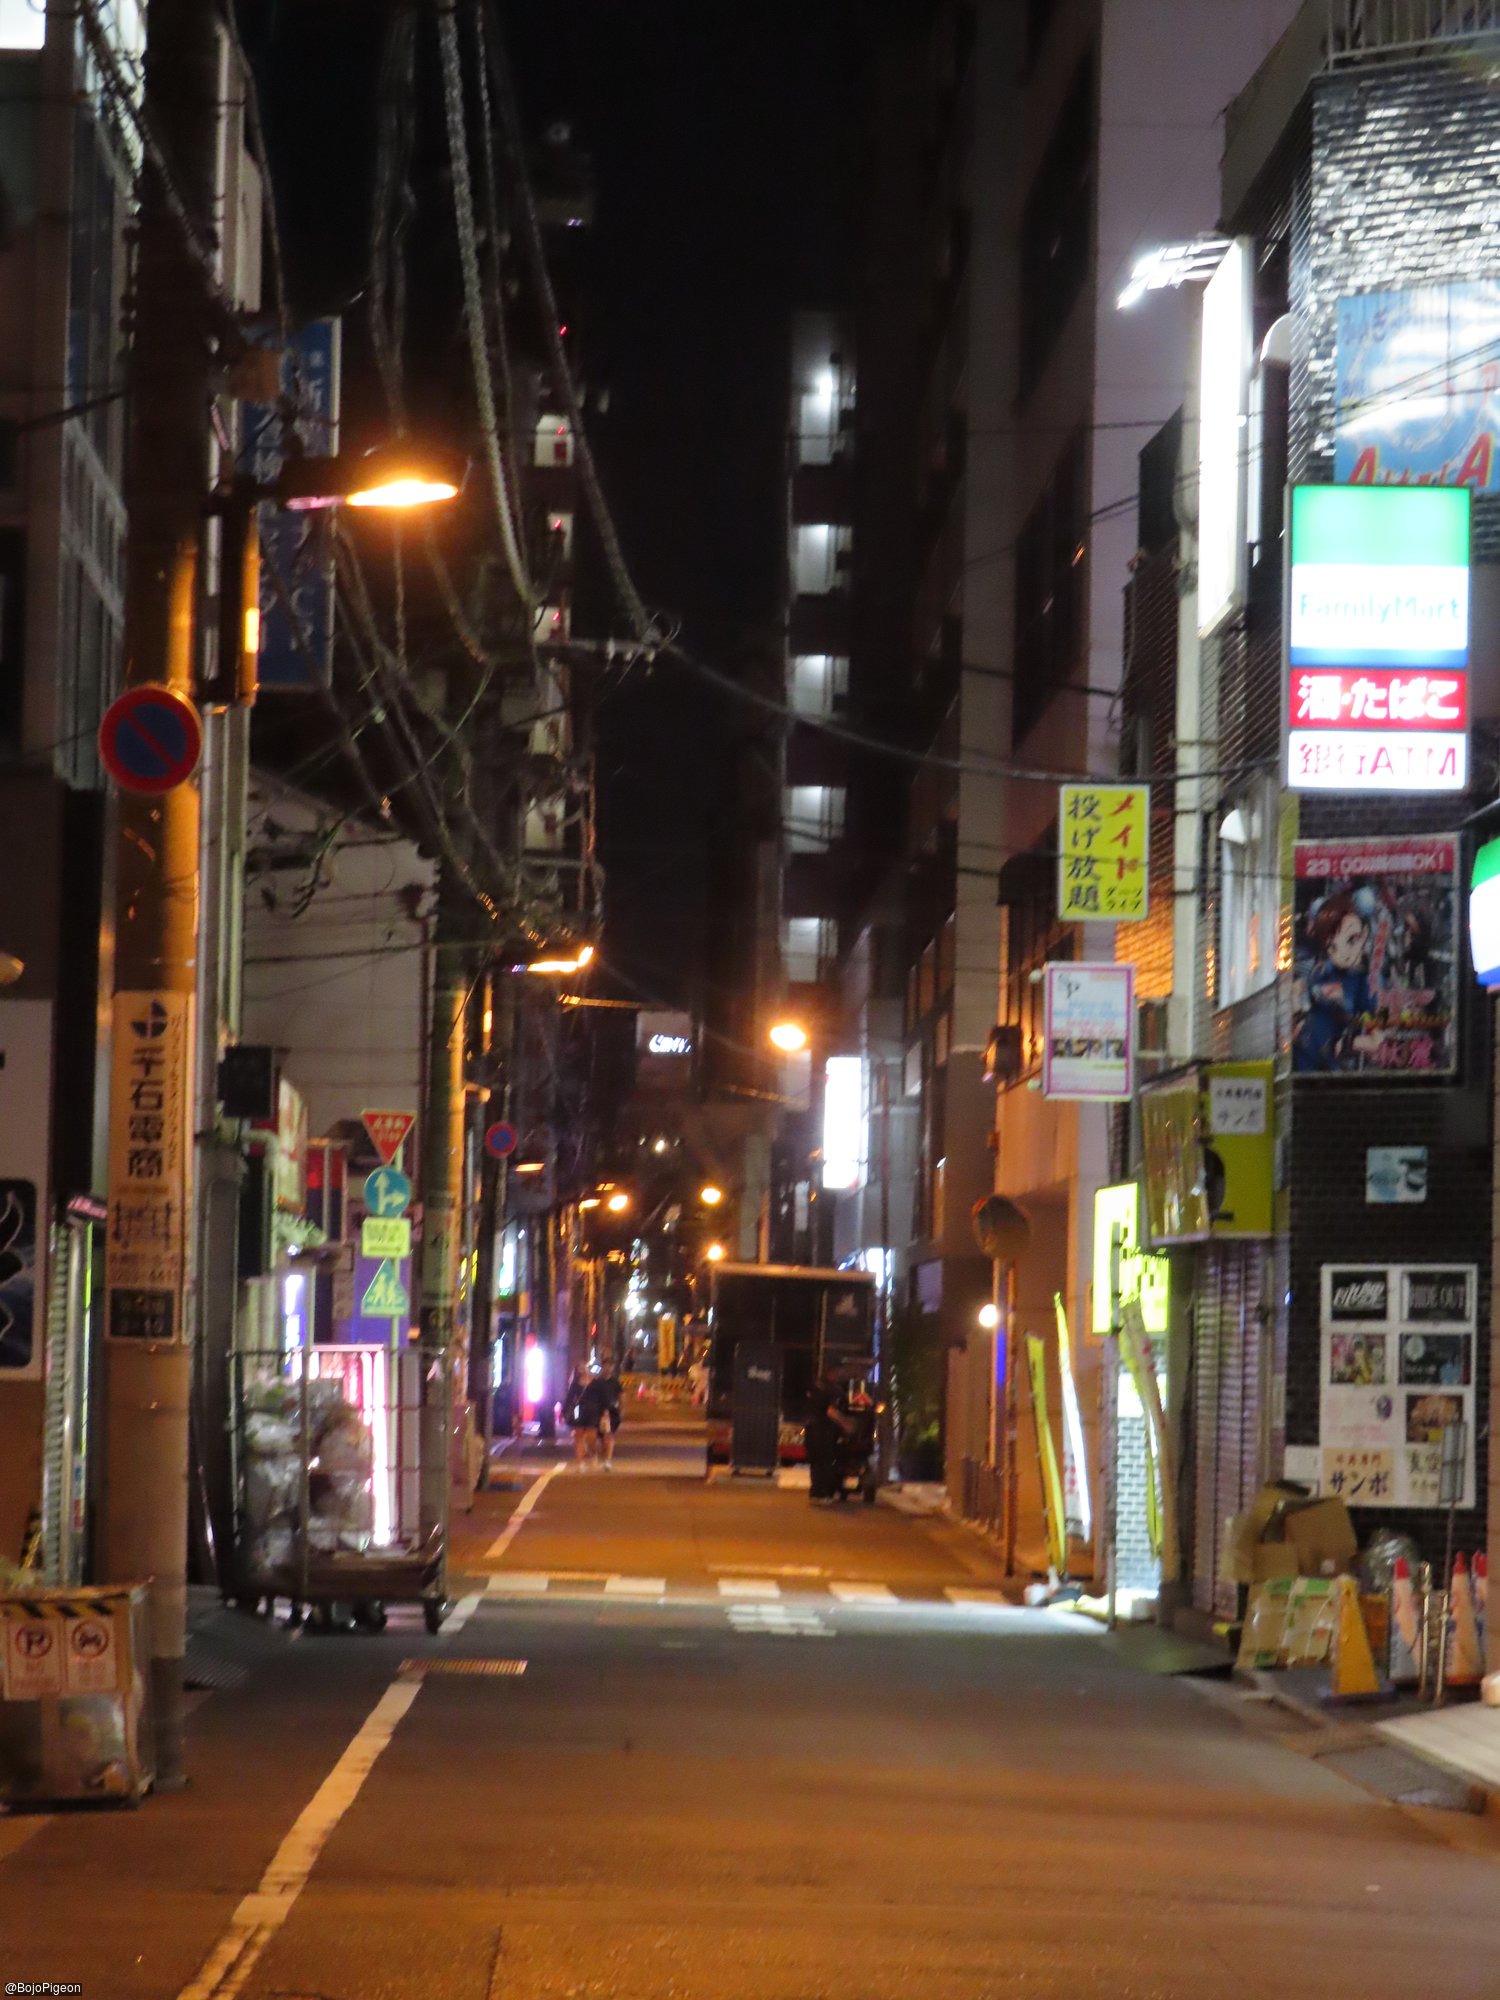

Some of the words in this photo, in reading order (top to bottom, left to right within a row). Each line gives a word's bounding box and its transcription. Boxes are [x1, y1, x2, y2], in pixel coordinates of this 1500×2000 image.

[1300, 594, 1460, 624] FamilyMart
[1066, 793, 1102, 913] 投げ放題
[129, 1046, 165, 1179] 千石電商
[1330, 1469, 1391, 1499] サンボ
